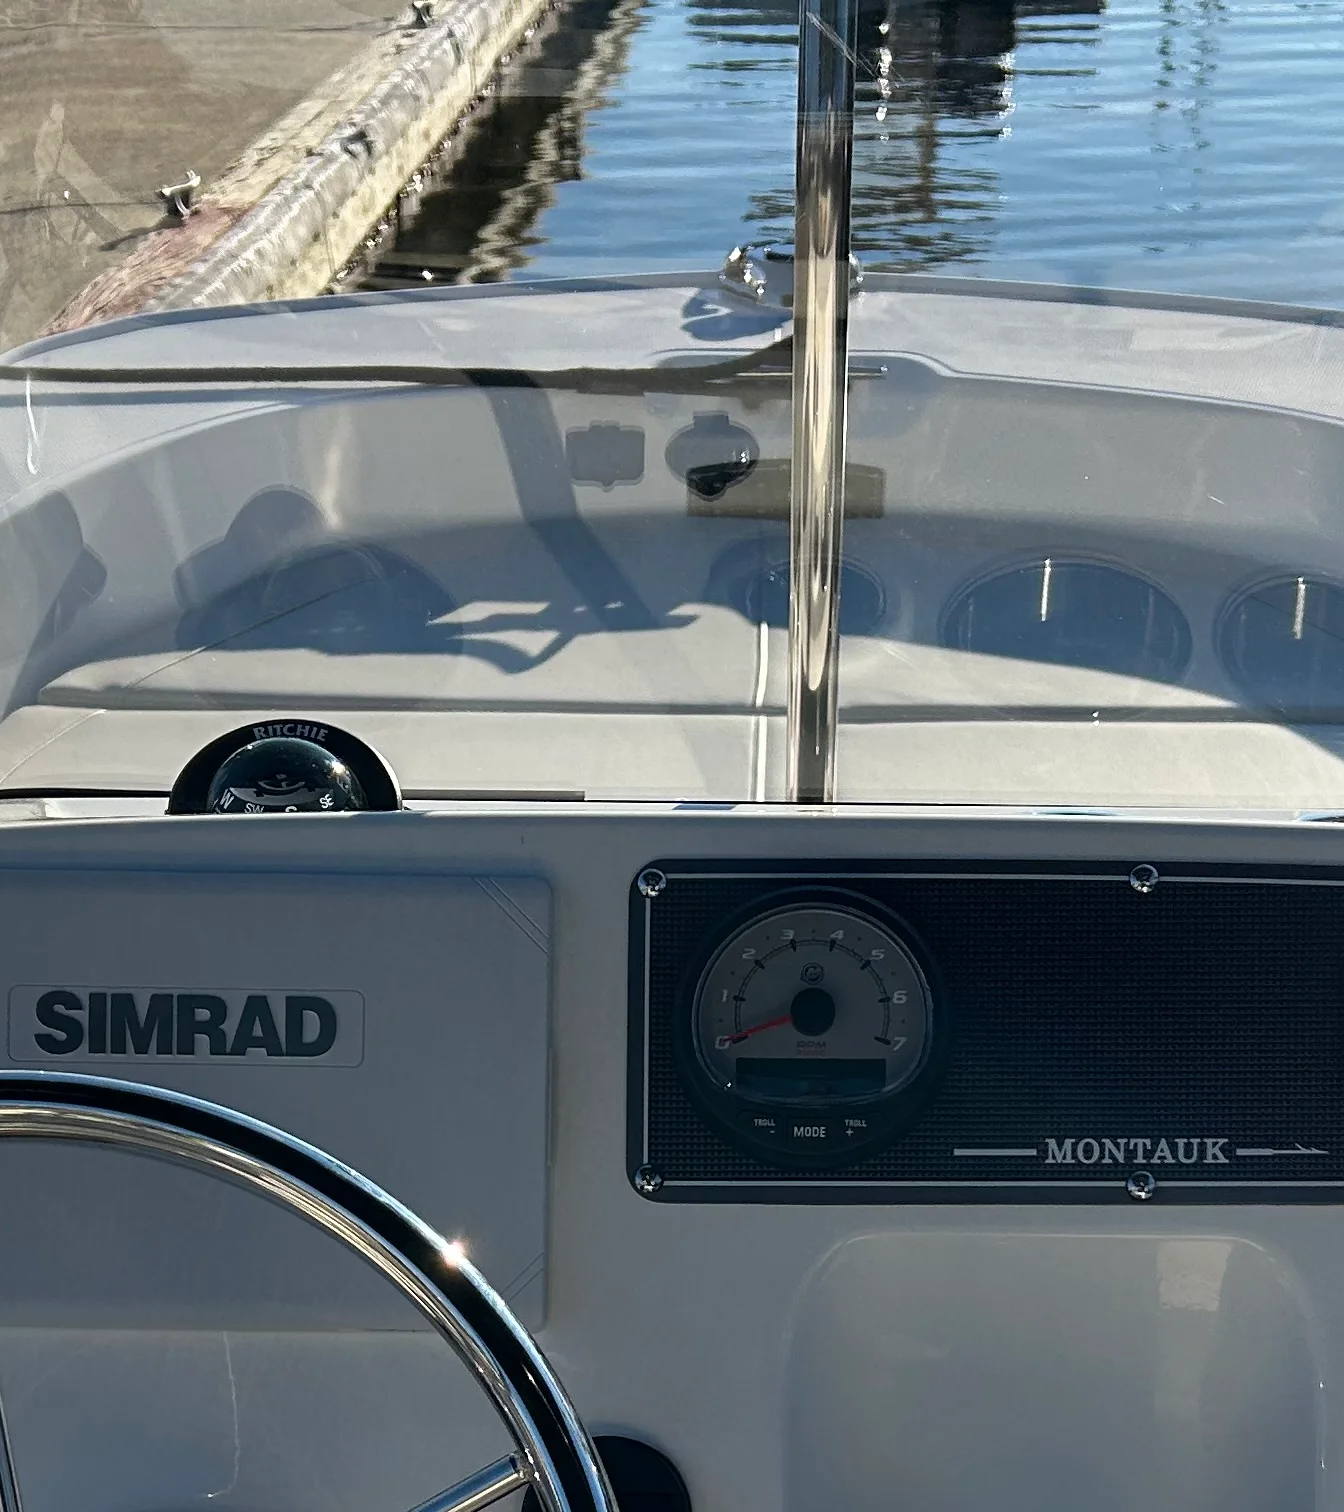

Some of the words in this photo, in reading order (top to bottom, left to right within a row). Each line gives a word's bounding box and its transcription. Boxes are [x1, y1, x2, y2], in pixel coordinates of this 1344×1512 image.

[253, 723, 329, 741] RITCHIE
[319, 793, 335, 809] SE
[780, 929, 795, 940] 3
[830, 930, 845, 940] 4
[742, 948, 756, 959] 2
[870, 949, 885, 960] 5
[721, 990, 728, 1002] 1
[892, 990, 907, 1004] 6
[33, 990, 337, 1057] SIMRAD
[893, 1036, 907, 1051] 7
[793, 1126, 827, 1138] MODE
[1044, 1137, 1230, 1164] MONTAUK
